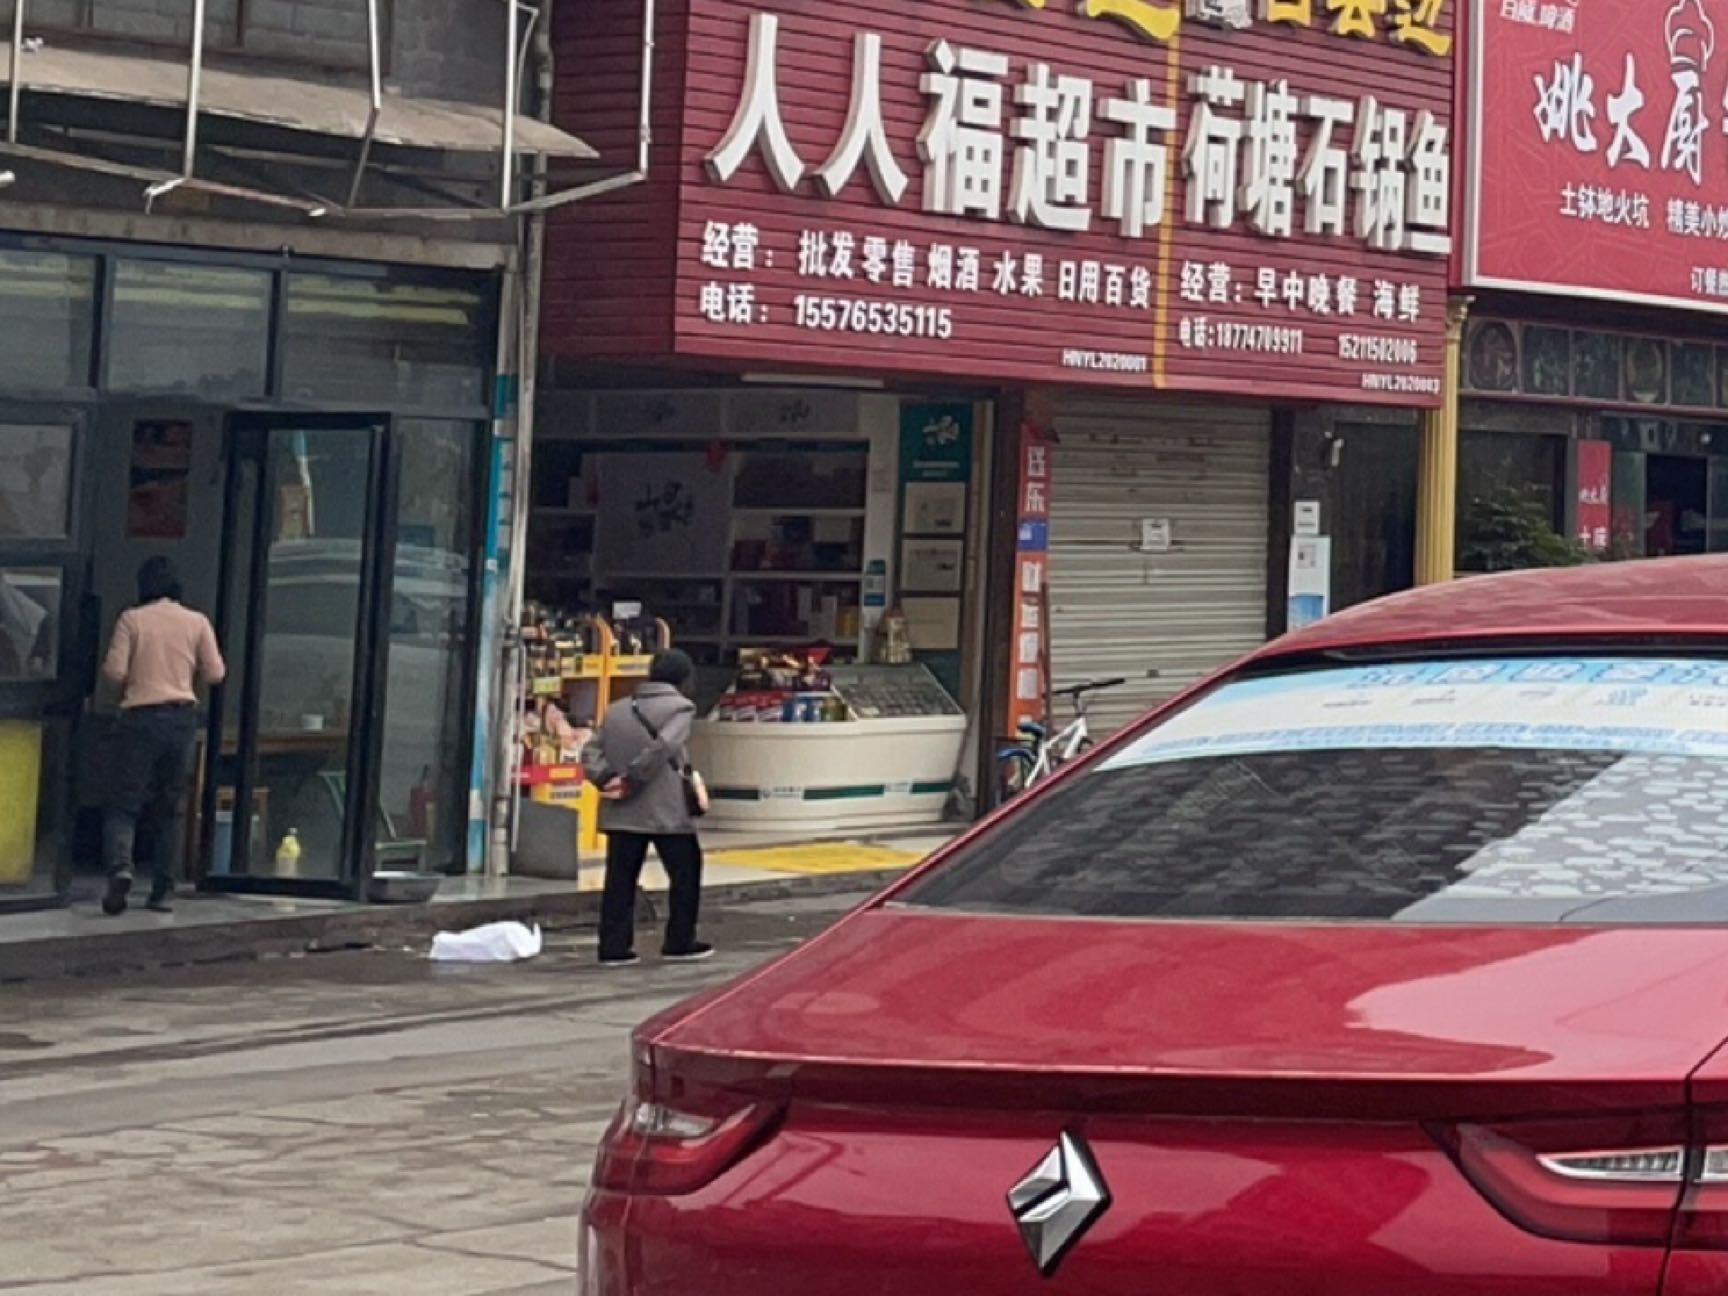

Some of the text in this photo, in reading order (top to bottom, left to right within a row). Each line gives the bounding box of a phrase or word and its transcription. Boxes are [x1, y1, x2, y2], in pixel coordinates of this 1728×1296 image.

[705, 12, 1177, 238] 人人福超市
[1182, 65, 1453, 253] 荷塘石锅鱼
[927, 243, 980, 292] 烟酒
[993, 251, 1044, 298] 水果
[1058, 260, 1152, 309] 日用百货
[1373, 280, 1420, 324] 海鲜
[794, 294, 952, 340] 15576535115
